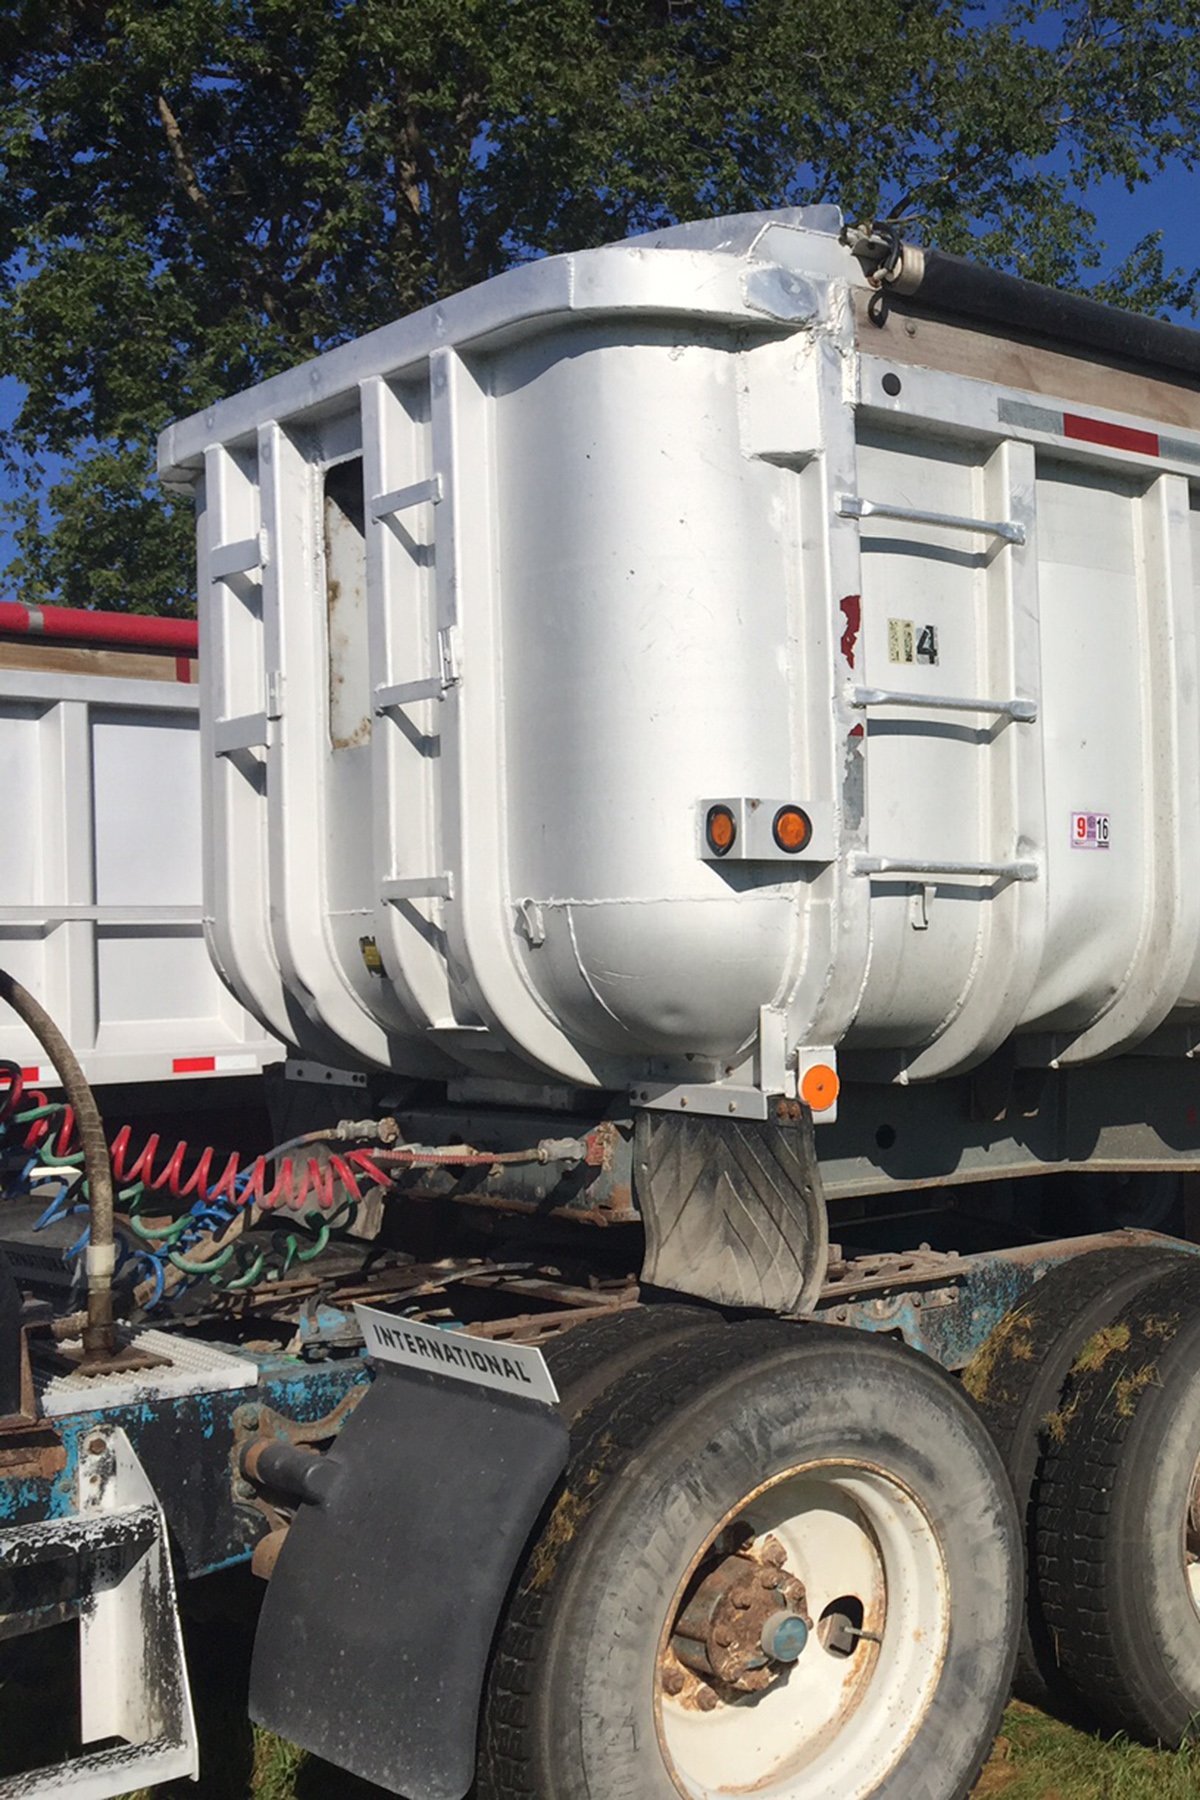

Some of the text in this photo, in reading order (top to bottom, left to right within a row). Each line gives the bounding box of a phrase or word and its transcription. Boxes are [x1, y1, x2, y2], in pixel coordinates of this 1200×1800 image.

[916, 624, 938, 665] 4
[1077, 816, 1086, 838] 9
[1096, 817, 1109, 840] 16
[372, 1323, 532, 1384] INTERNATIONAL
